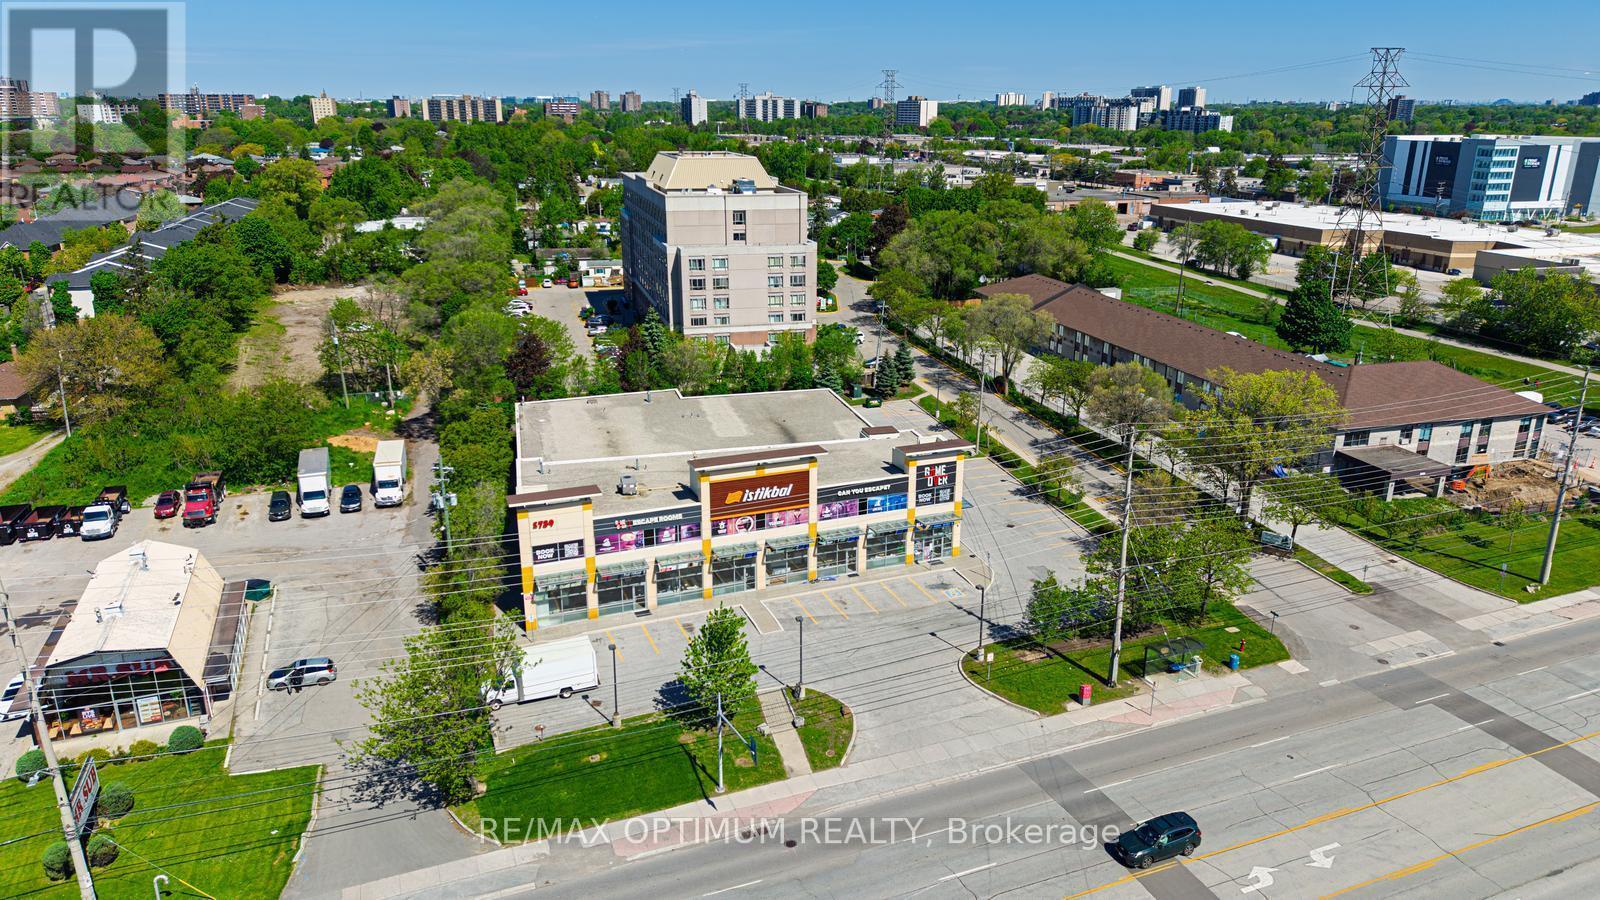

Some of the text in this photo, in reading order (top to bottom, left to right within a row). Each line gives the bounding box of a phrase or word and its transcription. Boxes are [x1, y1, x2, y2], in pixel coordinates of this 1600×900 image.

[742, 484, 793, 502] istikbal
[633, 516, 658, 526] ESCAPE
[536, 547, 555, 556] BOOK
[83, 766, 97, 799] SUB
